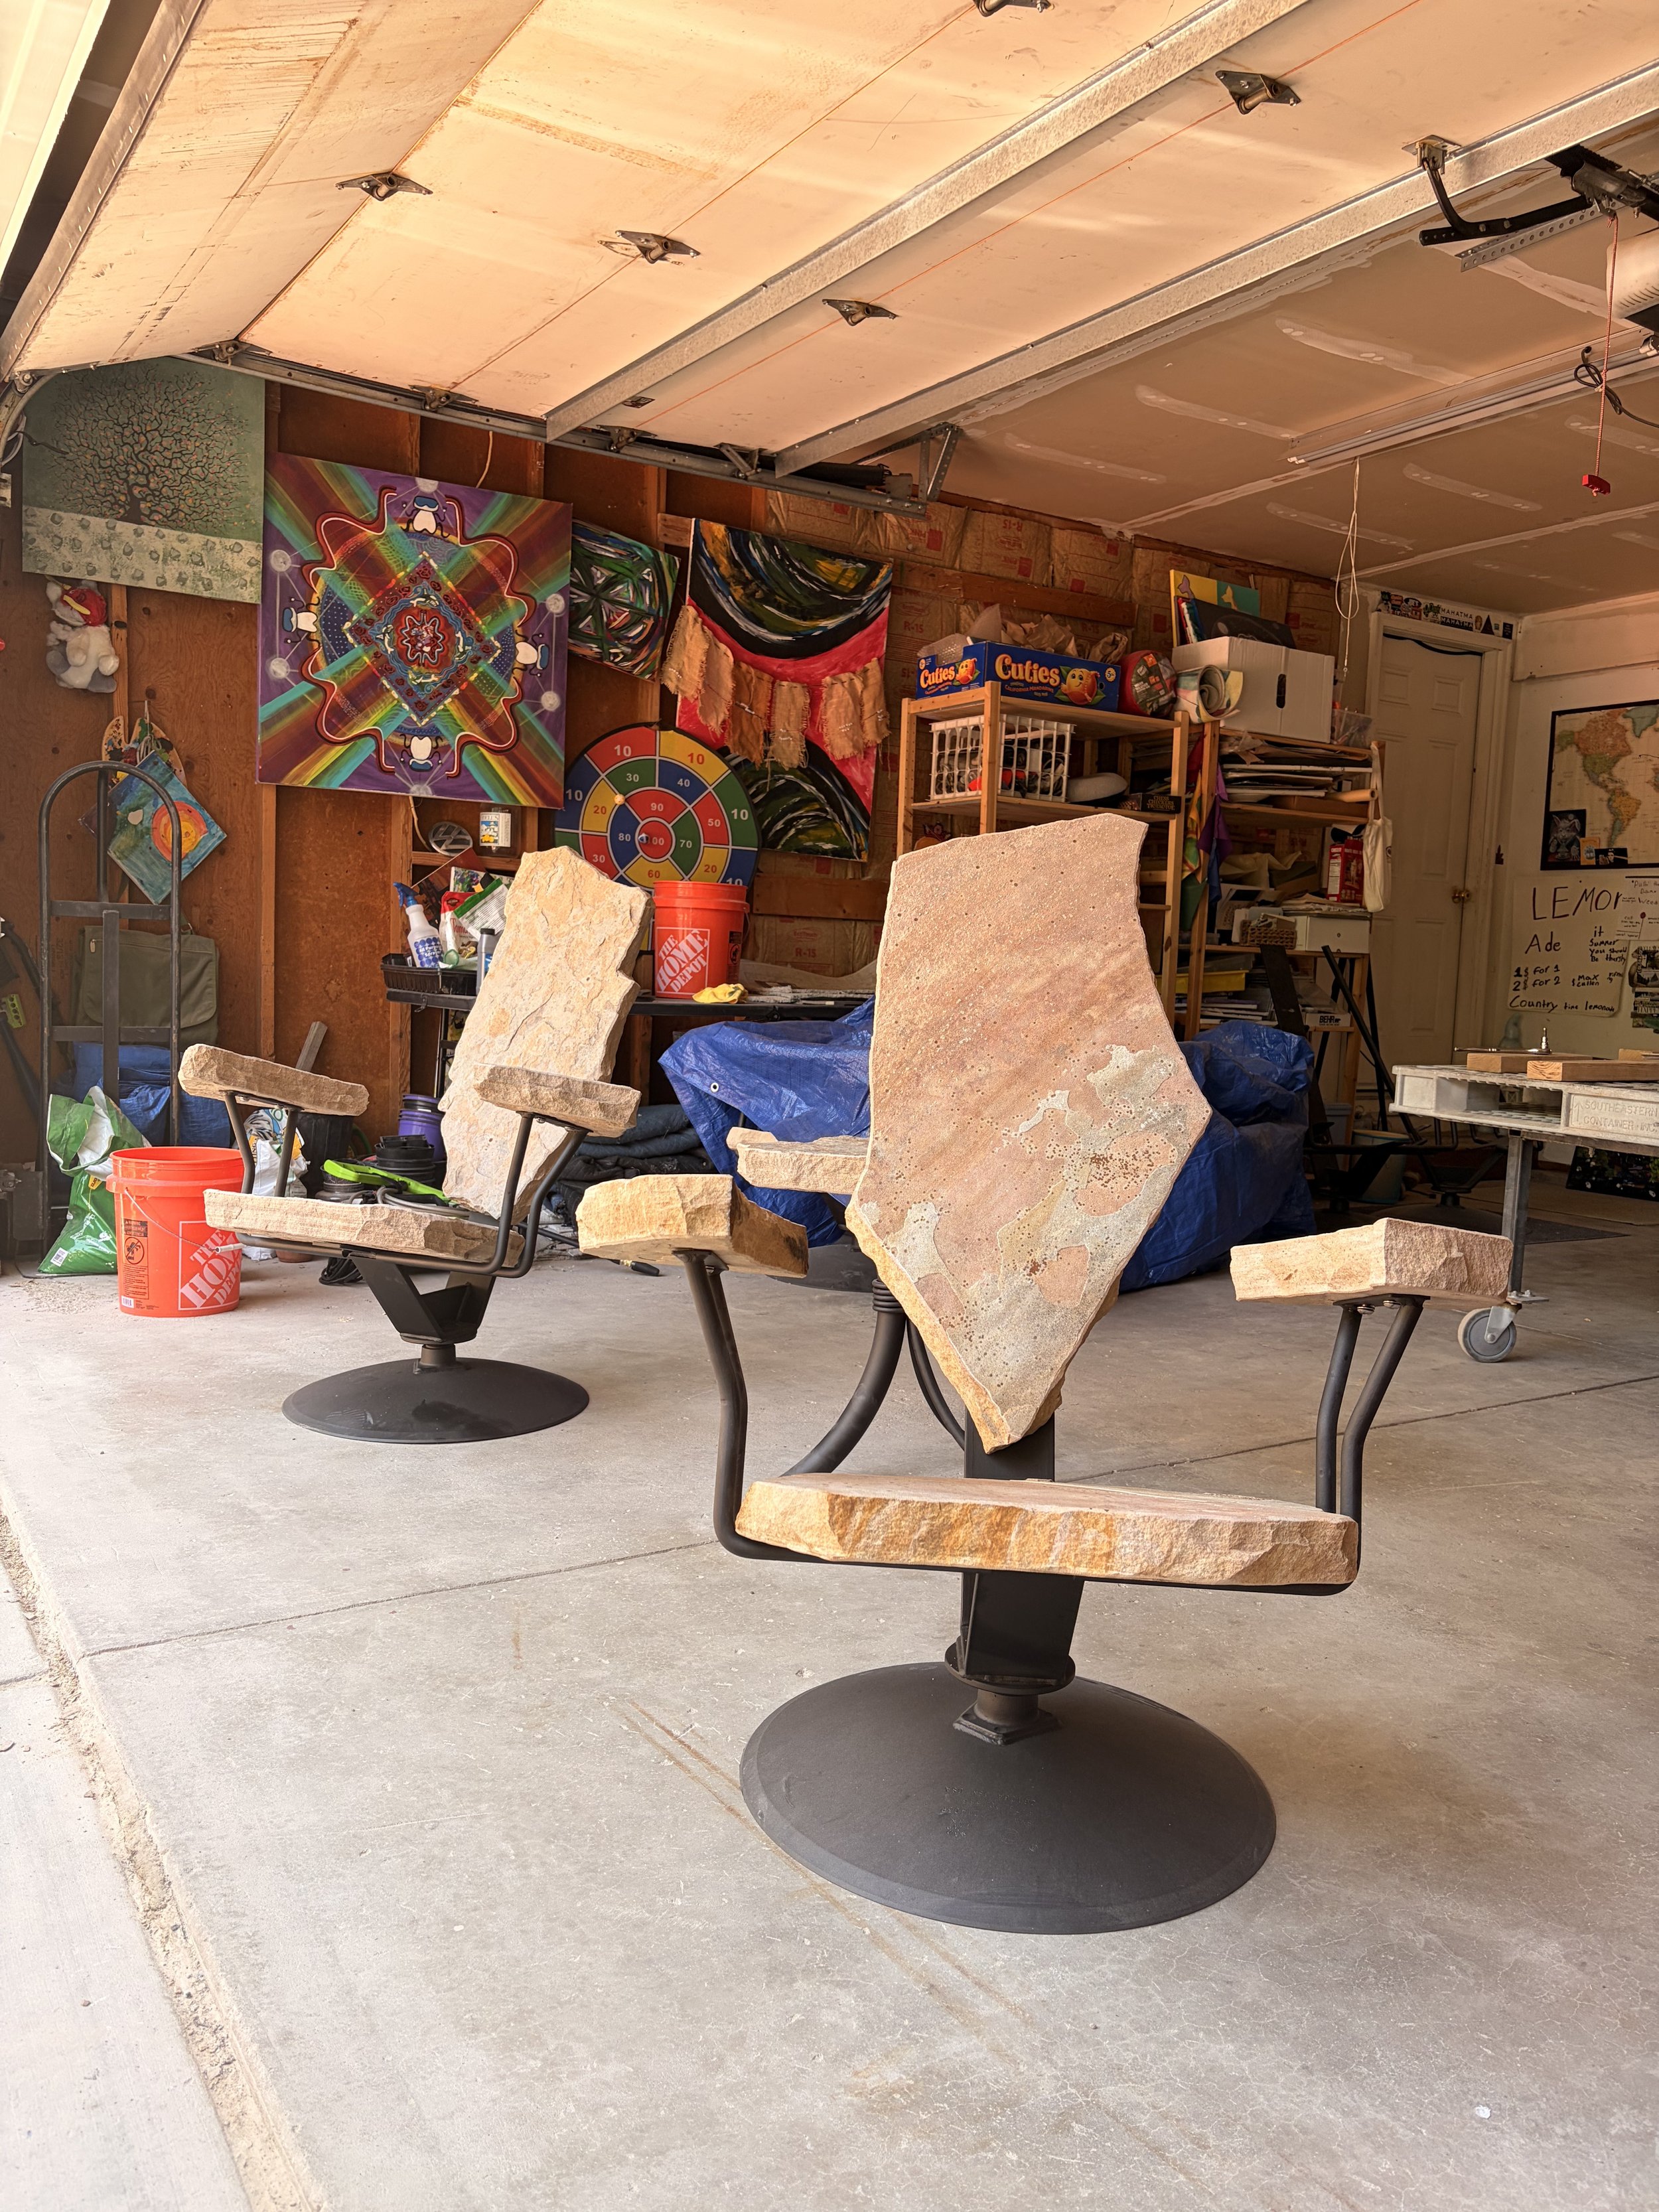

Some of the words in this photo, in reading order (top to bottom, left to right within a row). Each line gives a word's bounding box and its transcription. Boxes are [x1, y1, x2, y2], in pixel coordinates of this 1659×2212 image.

[1441, 607, 1473, 619] MAHATMA
[904, 621, 924, 634] R-15
[1441, 617, 1473, 628] MAHATMA
[995, 654, 1060, 687] Cuties
[920, 666, 956, 689] Cuties
[614, 745, 632, 757] 10
[687, 753, 705, 765] 10
[626, 773, 639, 782] 30
[677, 778, 690, 787] 40
[565, 789, 583, 801] 10
[593, 805, 607, 815] 20
[650, 802, 664, 812] 90
[731, 808, 749, 820] 10
[707, 818, 721, 828] 50
[618, 833, 631, 842] 80
[680, 840, 692, 848] 70
[593, 854, 605, 863] 30
[648, 870, 660, 879] 60
[704, 865, 717, 874] 20
[727, 877, 743, 887] 10
[1594, 925, 1603, 937] it
[658, 934, 678, 960] THE
[1525, 931, 1561, 954] Ade
[795, 948, 817, 958] R-15
[657, 930, 708, 992] HOME
[670, 954, 707, 992] DEPOT
[1553, 976, 1561, 985] 2
[1510, 995, 1557, 1013] Country
[1584, 1100, 1658, 1117] SOUTHEASTERN
[1583, 1116, 1634, 1129] CONTAINER
[189, 1230, 226, 1266] THE
[180, 1232, 242, 1308] HOM
